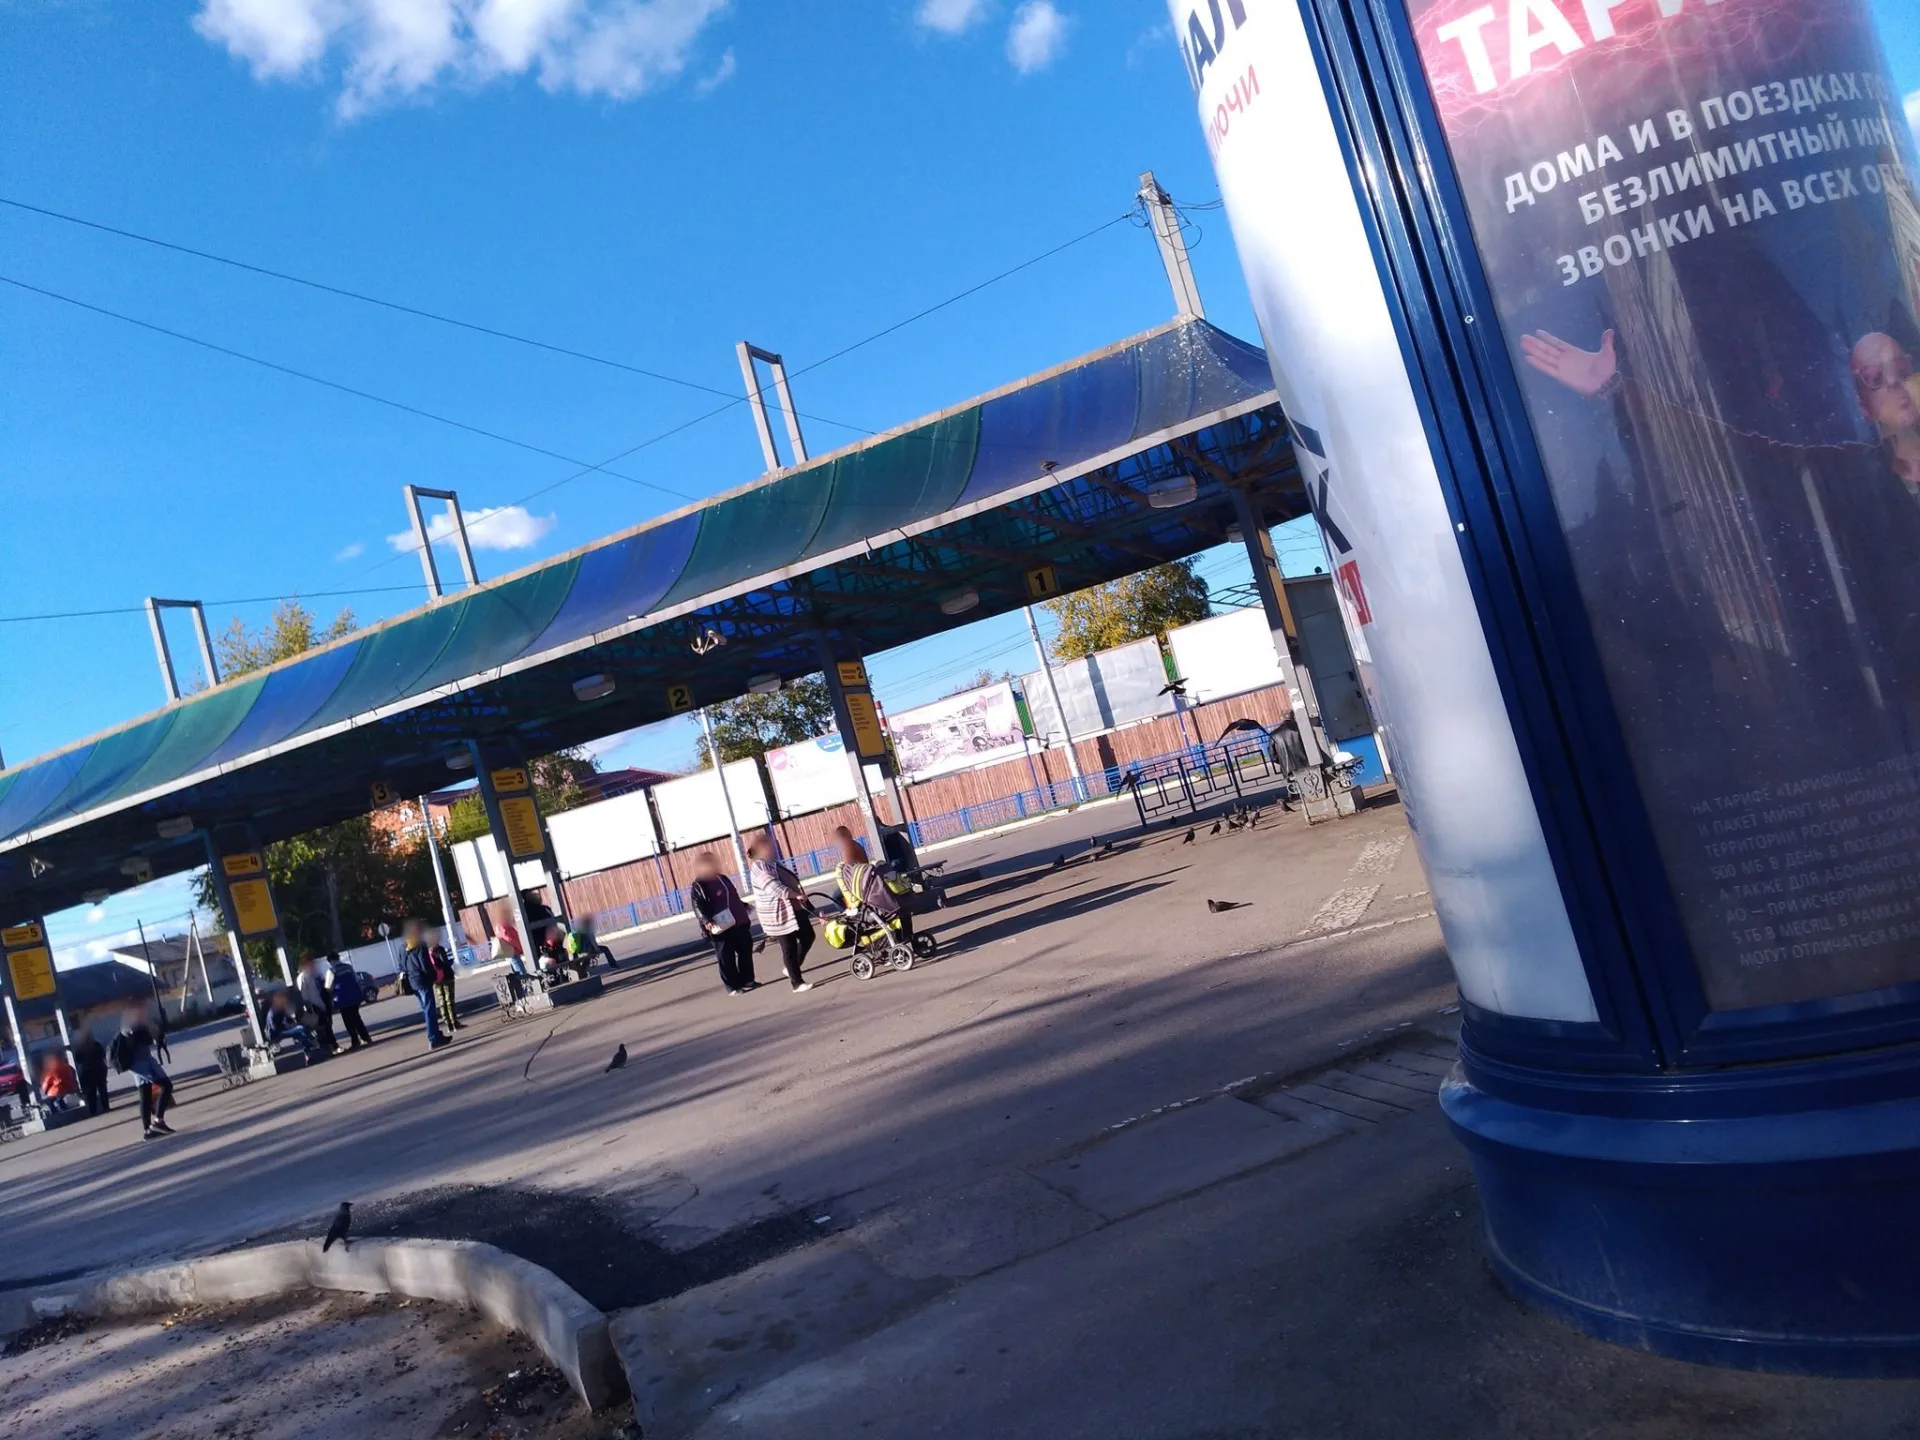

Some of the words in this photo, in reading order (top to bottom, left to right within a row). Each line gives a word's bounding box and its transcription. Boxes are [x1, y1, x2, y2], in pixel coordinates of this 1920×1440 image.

[1504, 134, 1624, 214] ДОМА
[1628, 118, 1660, 155] И
[1666, 108, 1693, 141] В
[1700, 71, 1862, 131] ПОЕЗДКАХ
[1577, 111, 1851, 226] БЕЗЛИМИТНЫЙ
[1556, 203, 1716, 287] ЗВОНКИ
[1721, 187, 1778, 228] НА
[1780, 166, 1860, 211] ВСЕХ
[1035, 572, 1047, 592] 1
[673, 688, 689, 707] 2
[1690, 800, 1713, 817] НА
[1712, 812, 1758, 836] ПАКЕТ
[1762, 801, 1814, 825] МИНУТ
[1818, 795, 1842, 814] НА
[1703, 828, 1798, 859] ТЕРРИТОРИИ
[1786, 850, 1824, 870] ДЕНЬ
[1732, 878, 1785, 899] ТАКЖЕ
[1789, 871, 1820, 891] ДЛЯ
[1766, 899, 1799, 916] ПРИ
[1740, 946, 1787, 967] МОГУТ
